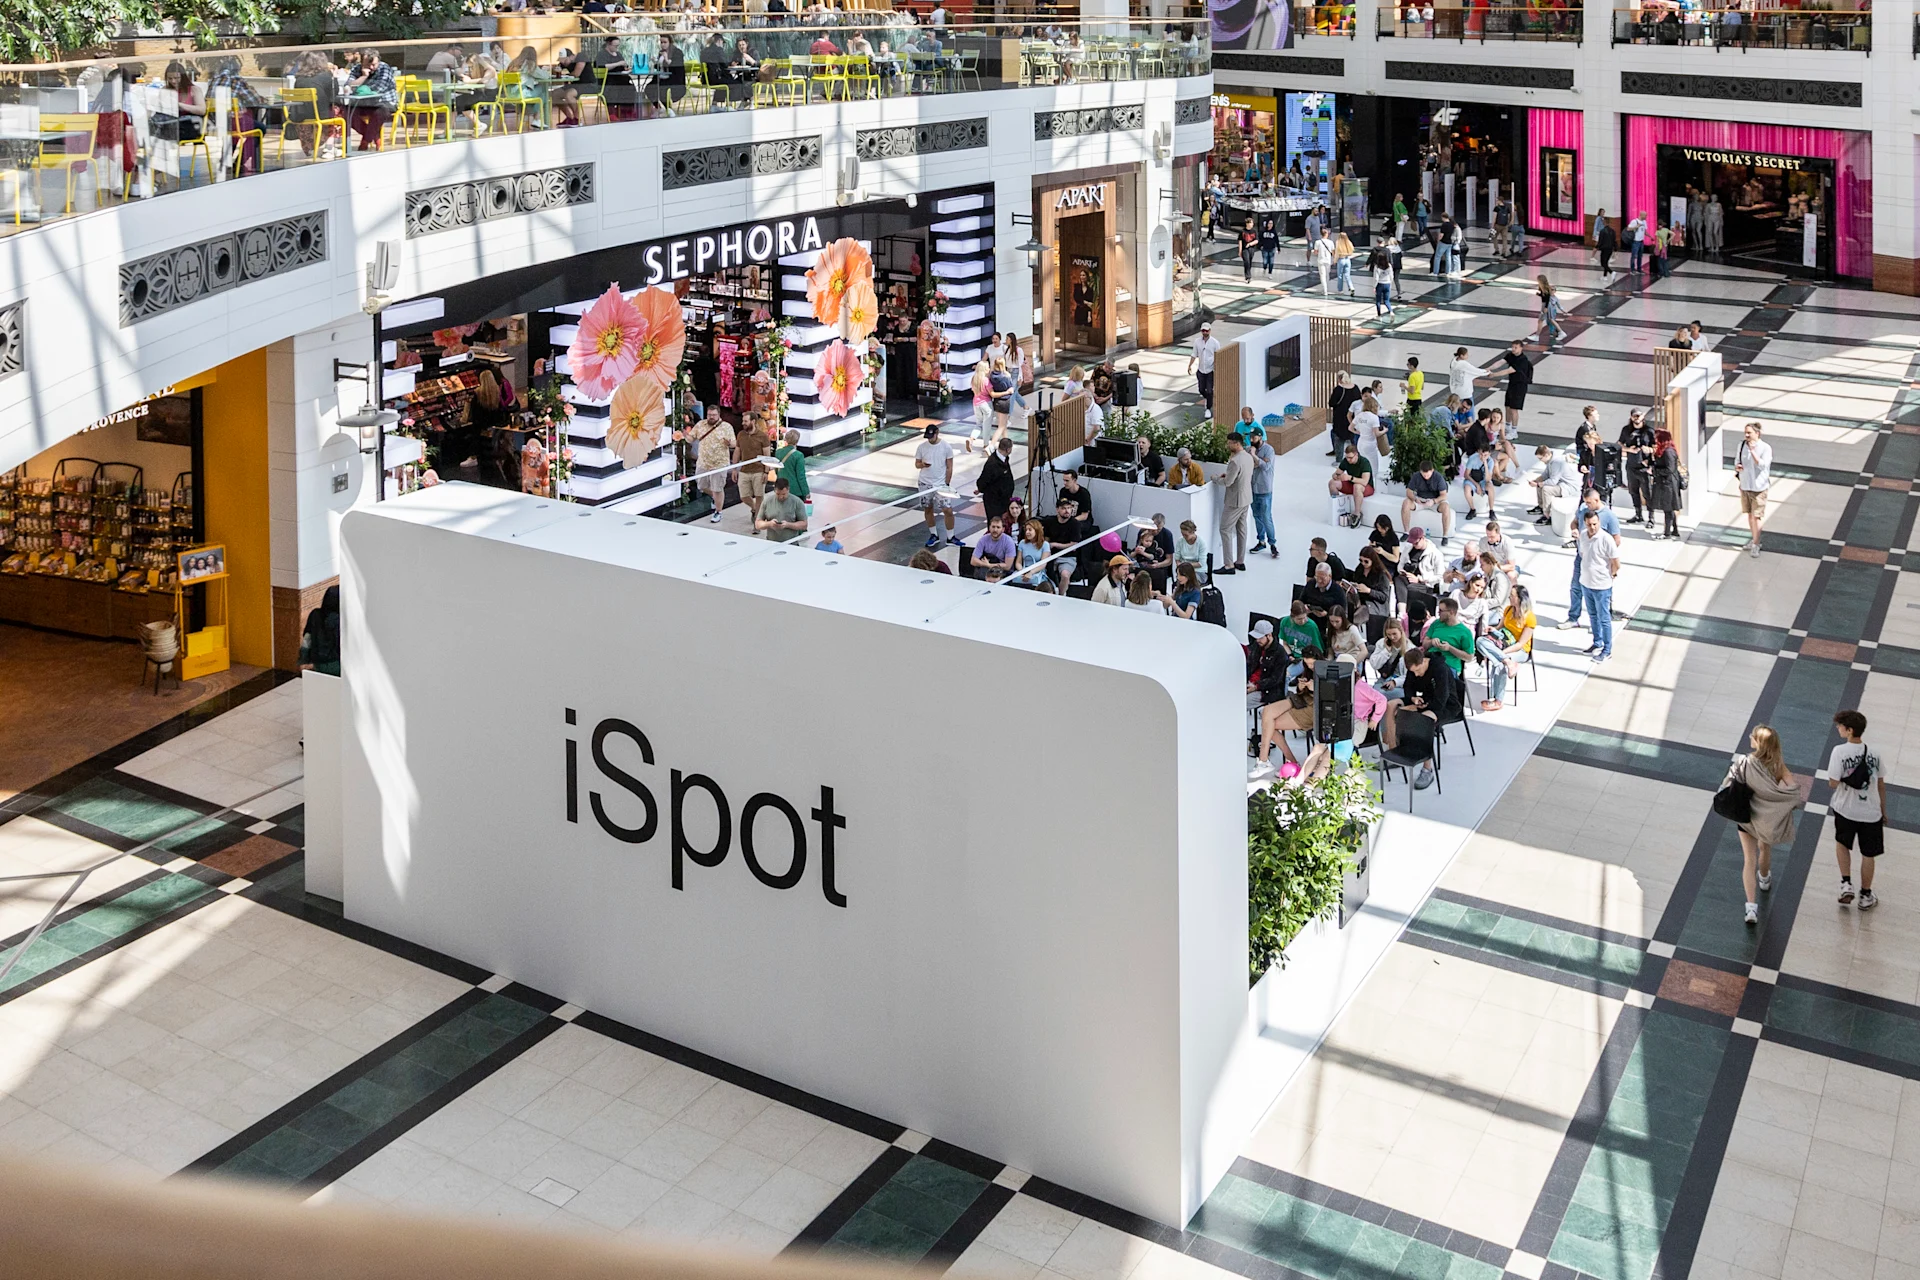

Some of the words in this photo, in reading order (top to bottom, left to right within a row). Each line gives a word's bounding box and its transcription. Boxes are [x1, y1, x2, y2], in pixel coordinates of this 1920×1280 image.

[1303, 94, 1326, 110] 4F
[1433, 107, 1461, 126] 4F
[1684, 149, 1751, 166] VICTORIA'S
[1755, 155, 1801, 170] SECRET
[1055, 184, 1108, 208] APART
[643, 216, 823, 285] SEPHORA
[564, 706, 848, 909] iSpot
